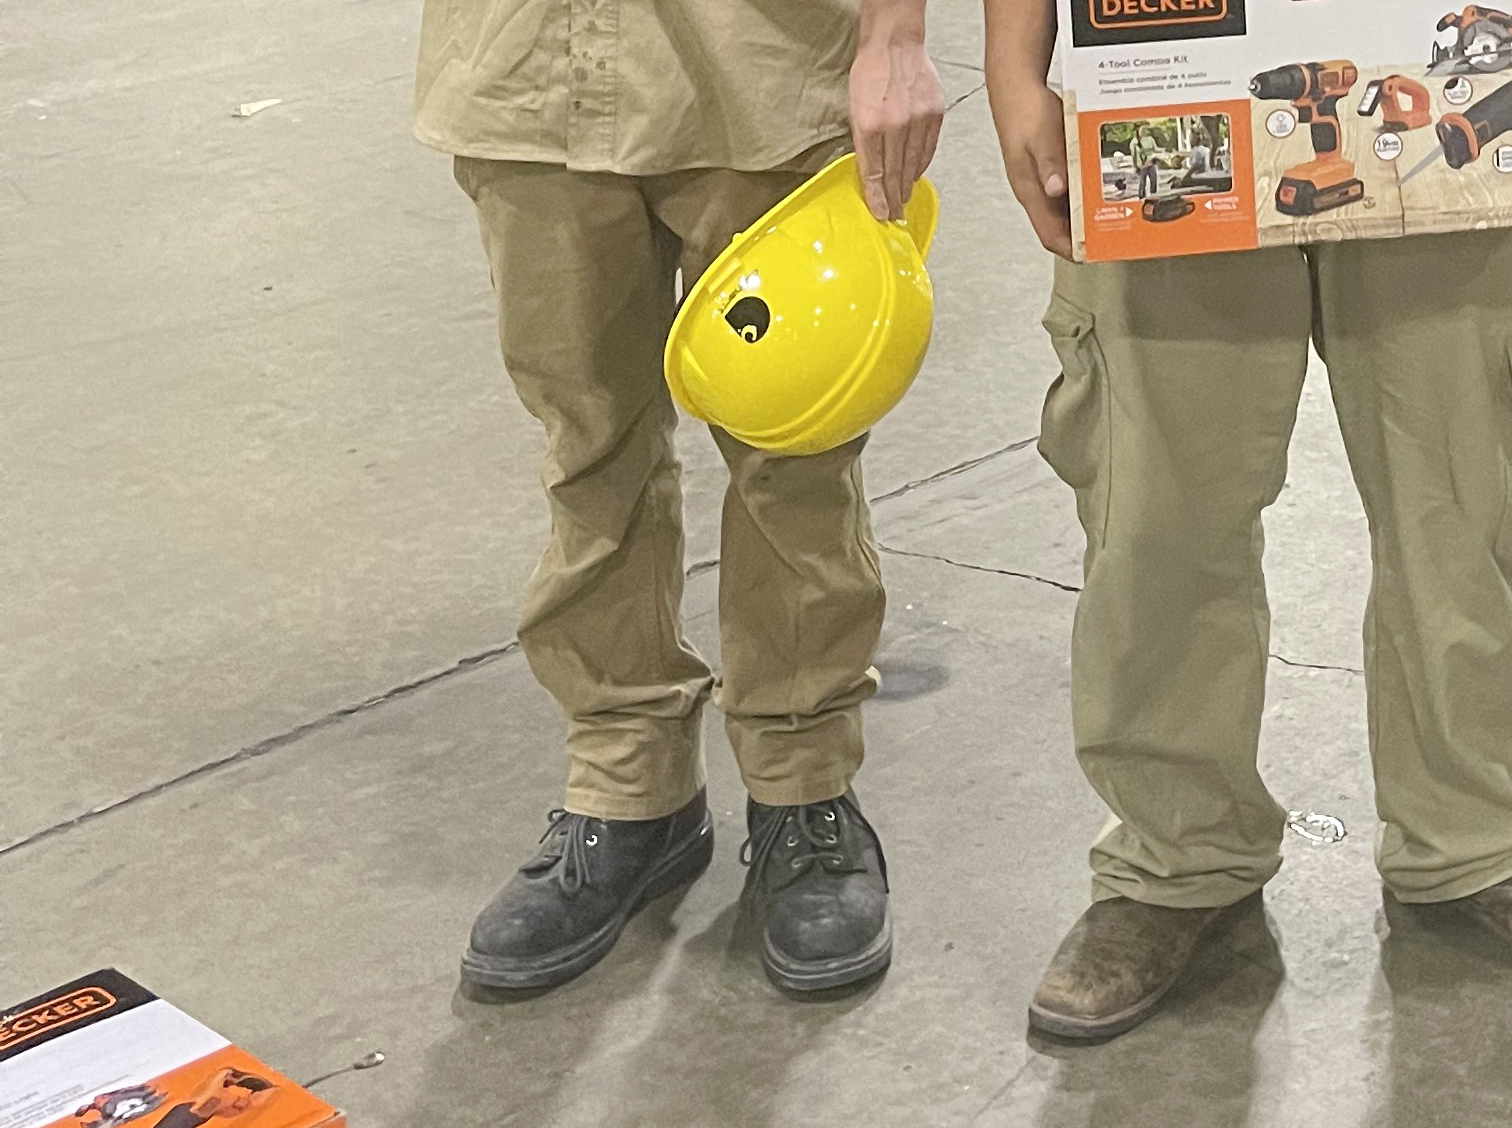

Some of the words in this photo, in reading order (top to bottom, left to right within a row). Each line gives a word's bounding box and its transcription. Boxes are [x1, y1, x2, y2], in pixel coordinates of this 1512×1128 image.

[1098, 59, 1130, 69] 4-Tool
[1174, 55, 1188, 64] Kit
[0, 995, 100, 1042] ECKER
